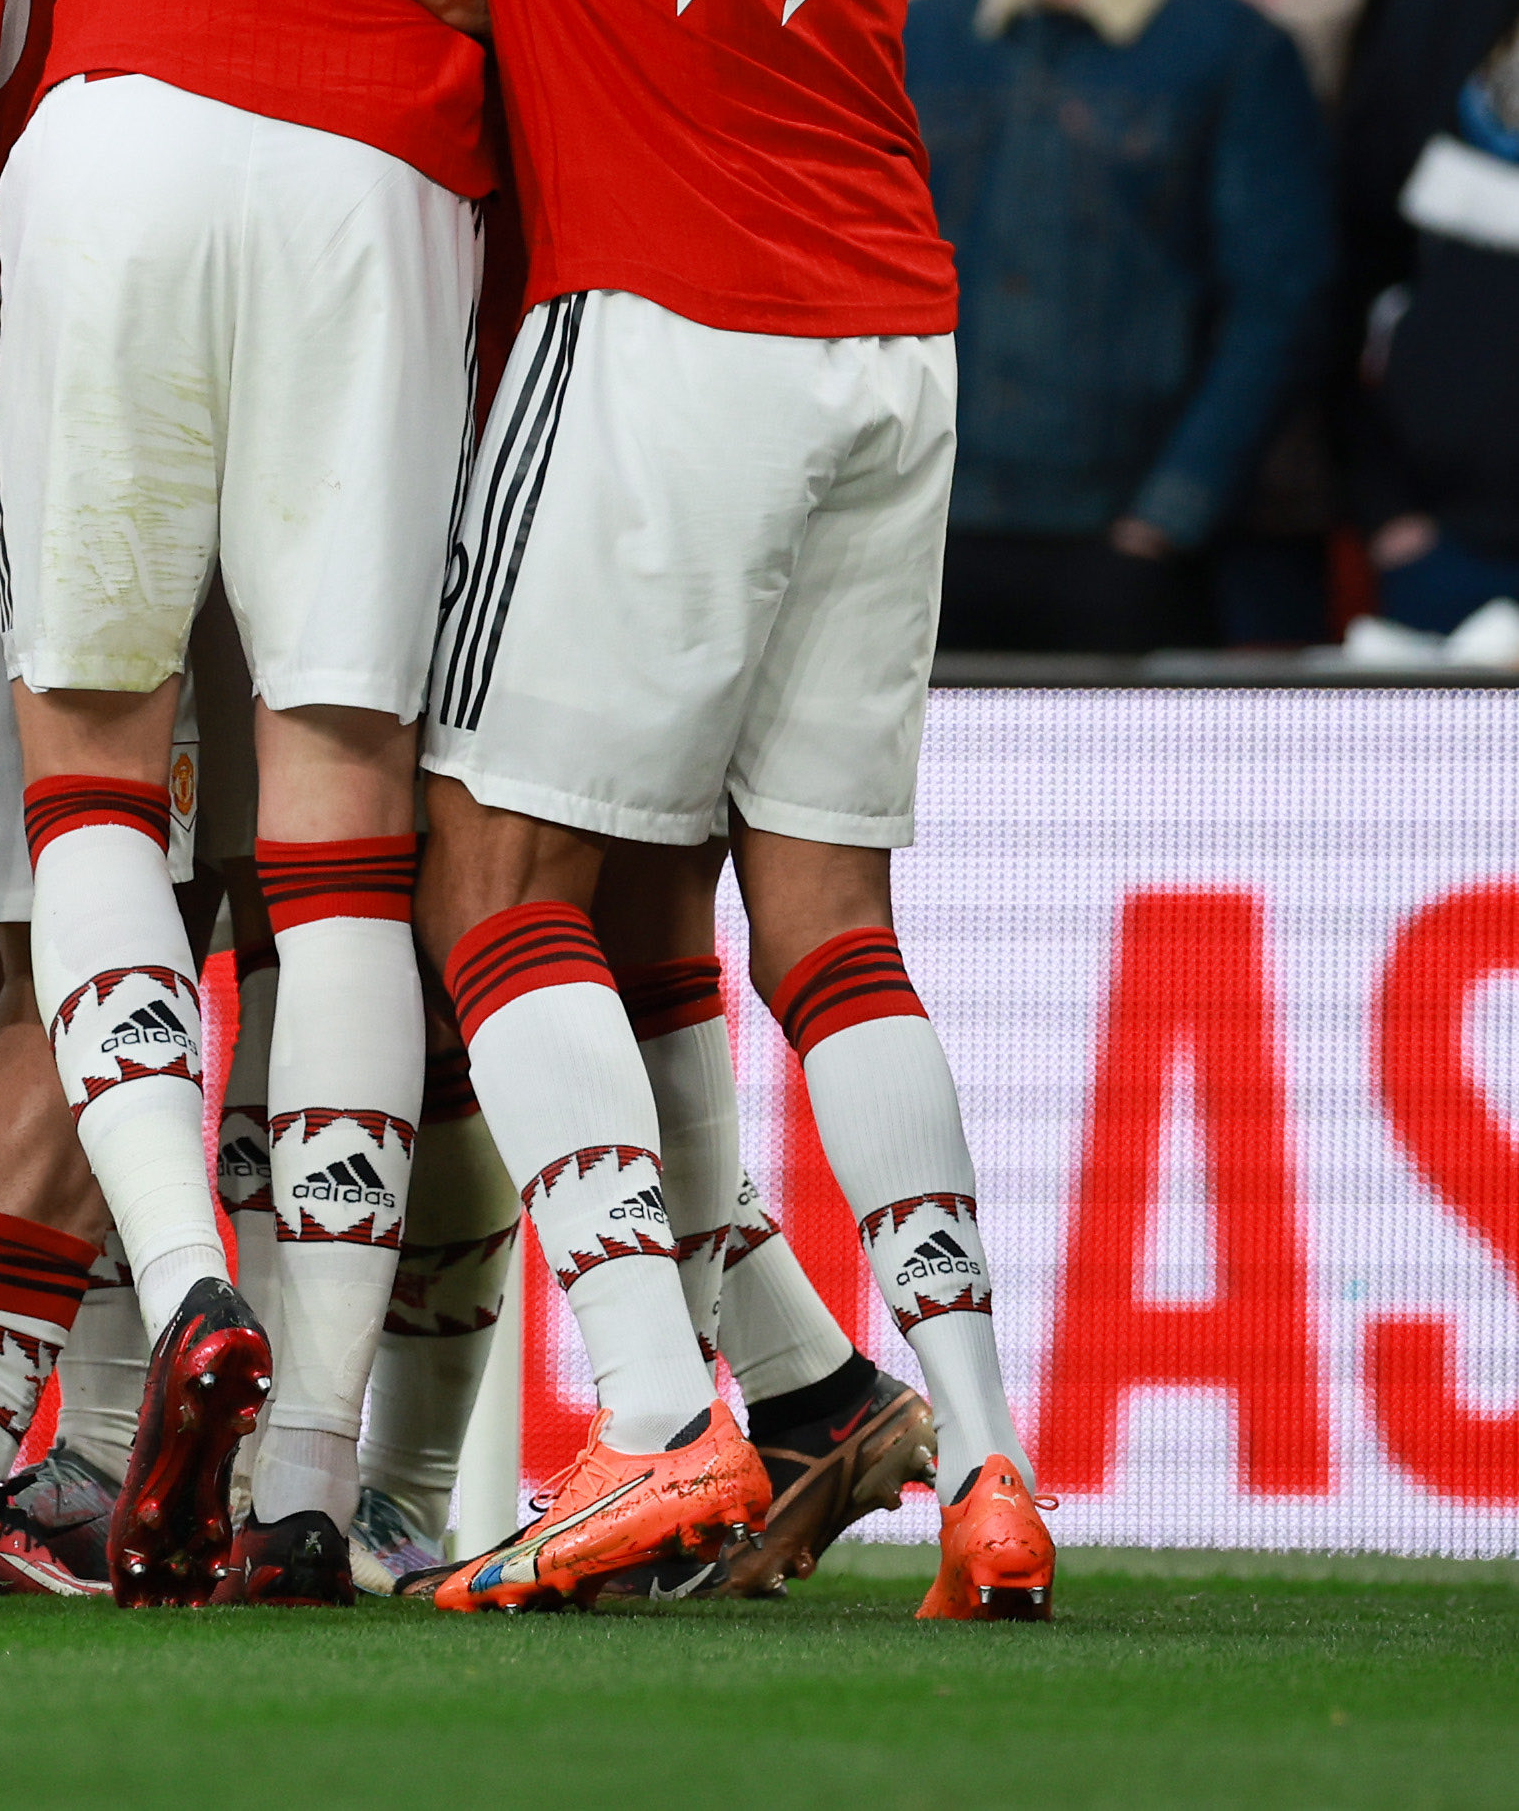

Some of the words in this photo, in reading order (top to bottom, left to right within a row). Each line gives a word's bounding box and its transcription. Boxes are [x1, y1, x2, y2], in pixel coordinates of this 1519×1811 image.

[101, 1026, 199, 1057] adidas
[292, 1180, 396, 1208] adidas
[896, 1256, 981, 1286] adidas
